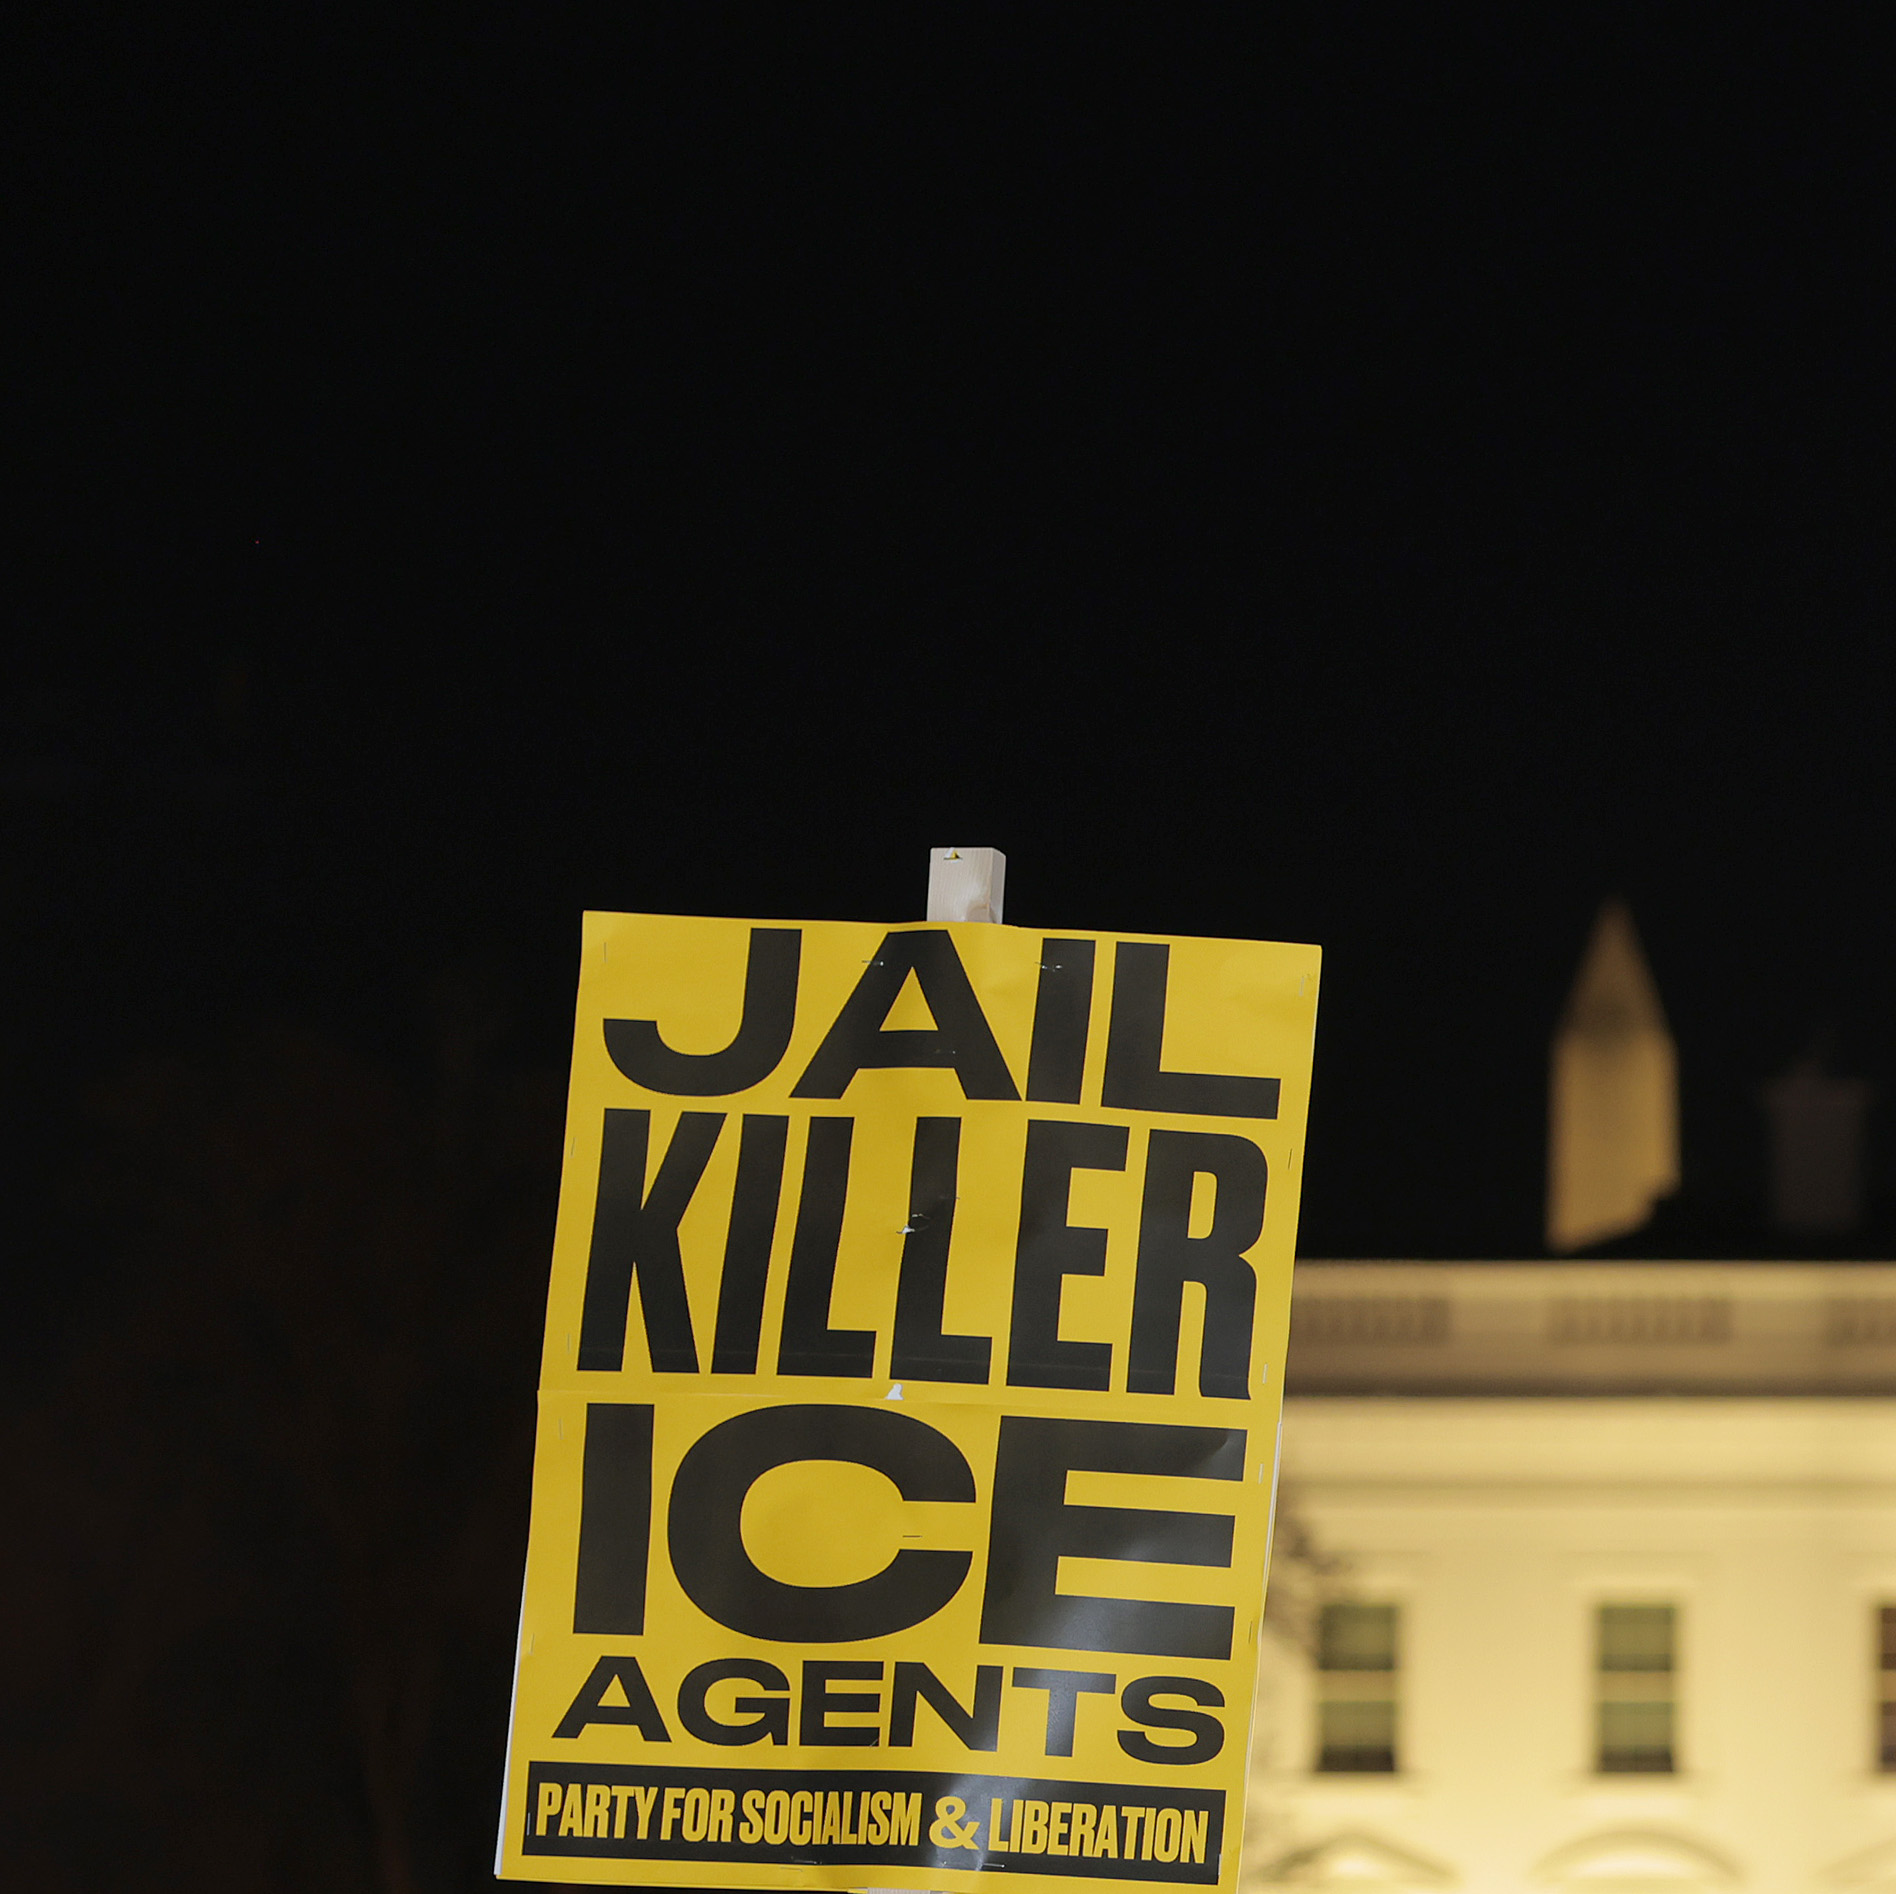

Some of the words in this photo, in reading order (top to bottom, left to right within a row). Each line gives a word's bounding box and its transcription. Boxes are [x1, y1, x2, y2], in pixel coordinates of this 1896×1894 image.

[602, 927, 1282, 1120] JAIL
[577, 1108, 1269, 1400] KILLER
[573, 1403, 1249, 1661] ICE
[551, 1655, 1226, 1767] AGENTS
[535, 1781, 659, 1839] PARTY
[660, 1788, 735, 1842] FOR
[738, 1789, 922, 1848] SOCIALISM
[928, 1796, 980, 1851] &
[988, 1798, 1210, 1865] LIBERATION
